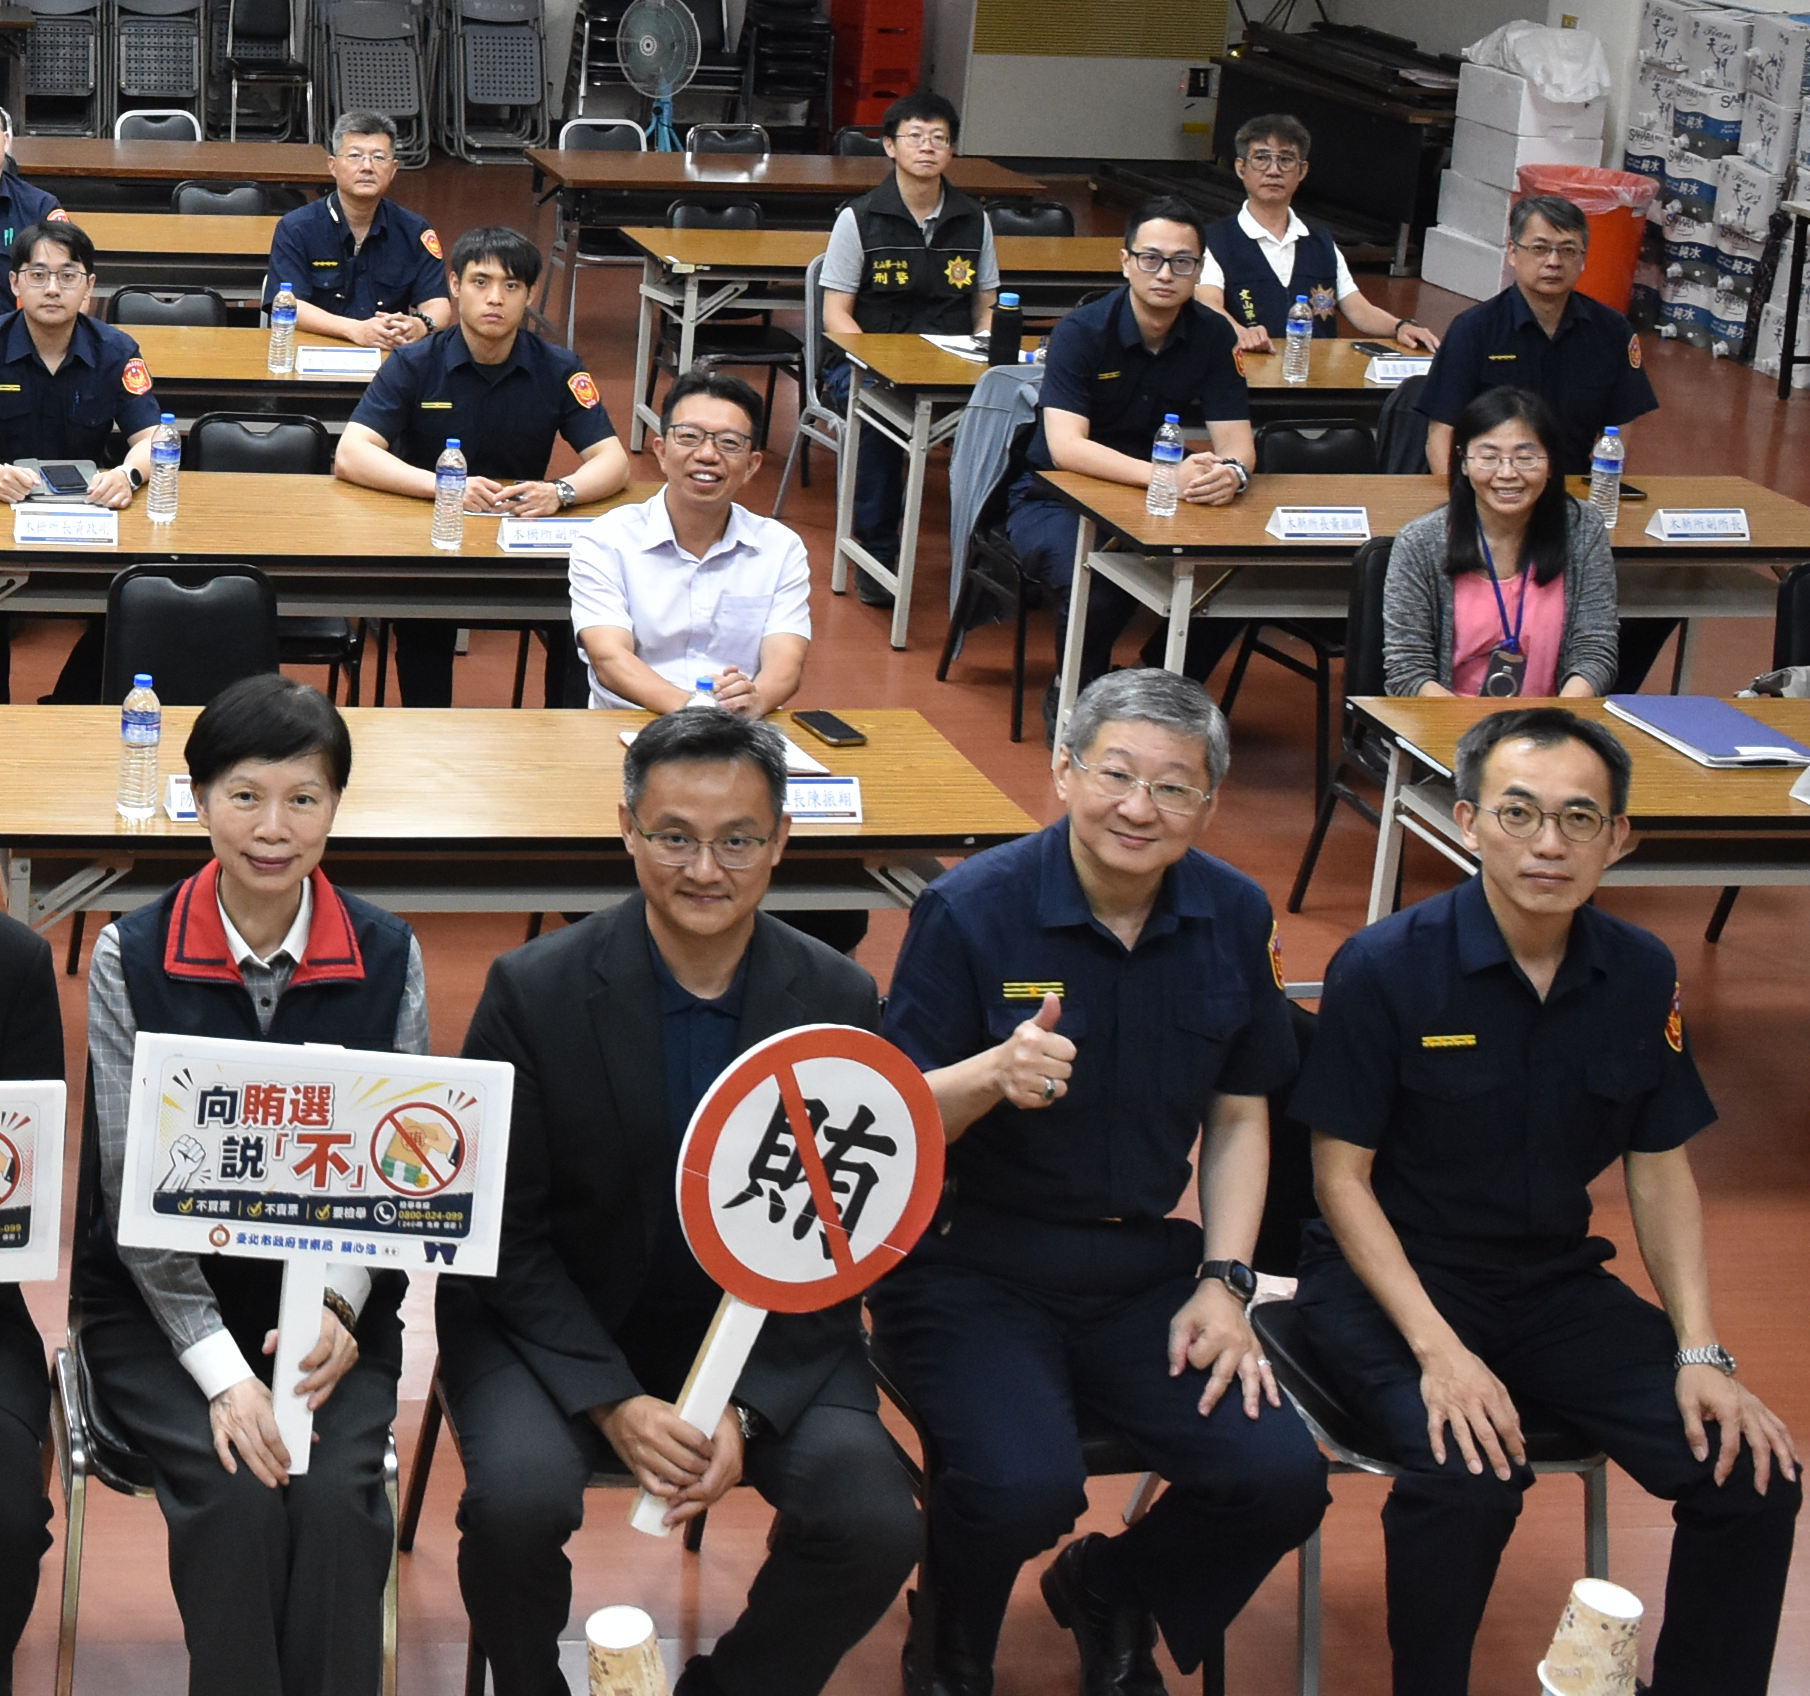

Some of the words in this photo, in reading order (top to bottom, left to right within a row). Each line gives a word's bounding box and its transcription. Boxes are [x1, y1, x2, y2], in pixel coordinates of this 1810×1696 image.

[197, 1084, 331, 1126] 向賄選
[721, 1093, 897, 1260] 賄
[398, 1210, 464, 1221] 0800-024-099
